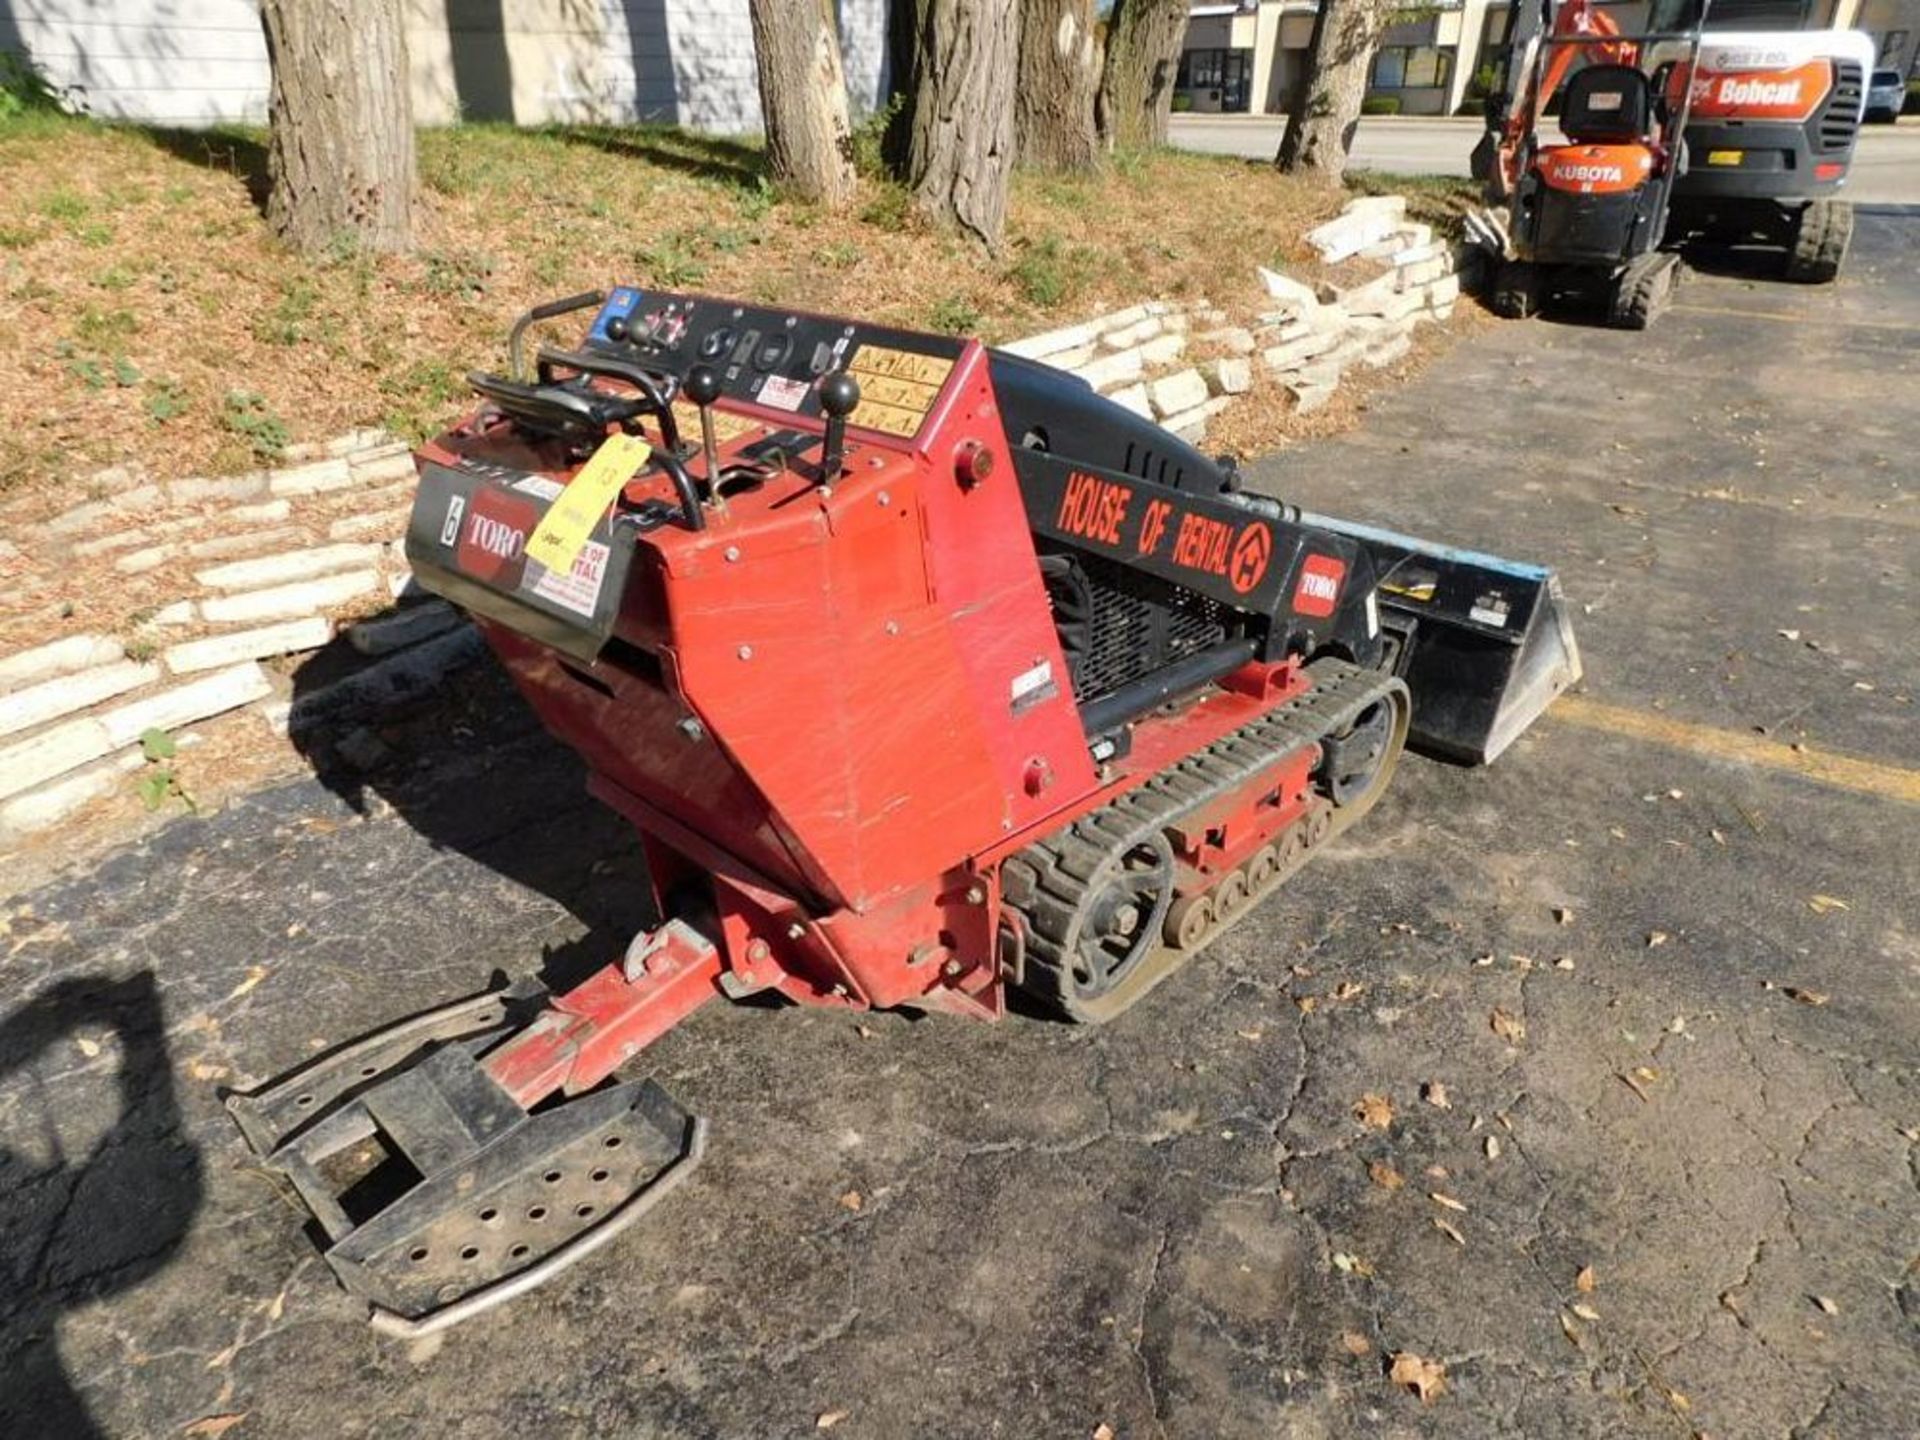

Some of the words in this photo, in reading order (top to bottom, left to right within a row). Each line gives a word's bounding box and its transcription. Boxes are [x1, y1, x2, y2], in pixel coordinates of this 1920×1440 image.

[1719, 79, 1801, 104] Bobcat
[1553, 165, 1622, 182] KUBOTA
[470, 513, 524, 561] TORO
[1058, 473, 1132, 544] HOUSE
[1139, 499, 1172, 554] OF
[1173, 512, 1235, 575] RENTAL
[1301, 572, 1336, 602] TORO
